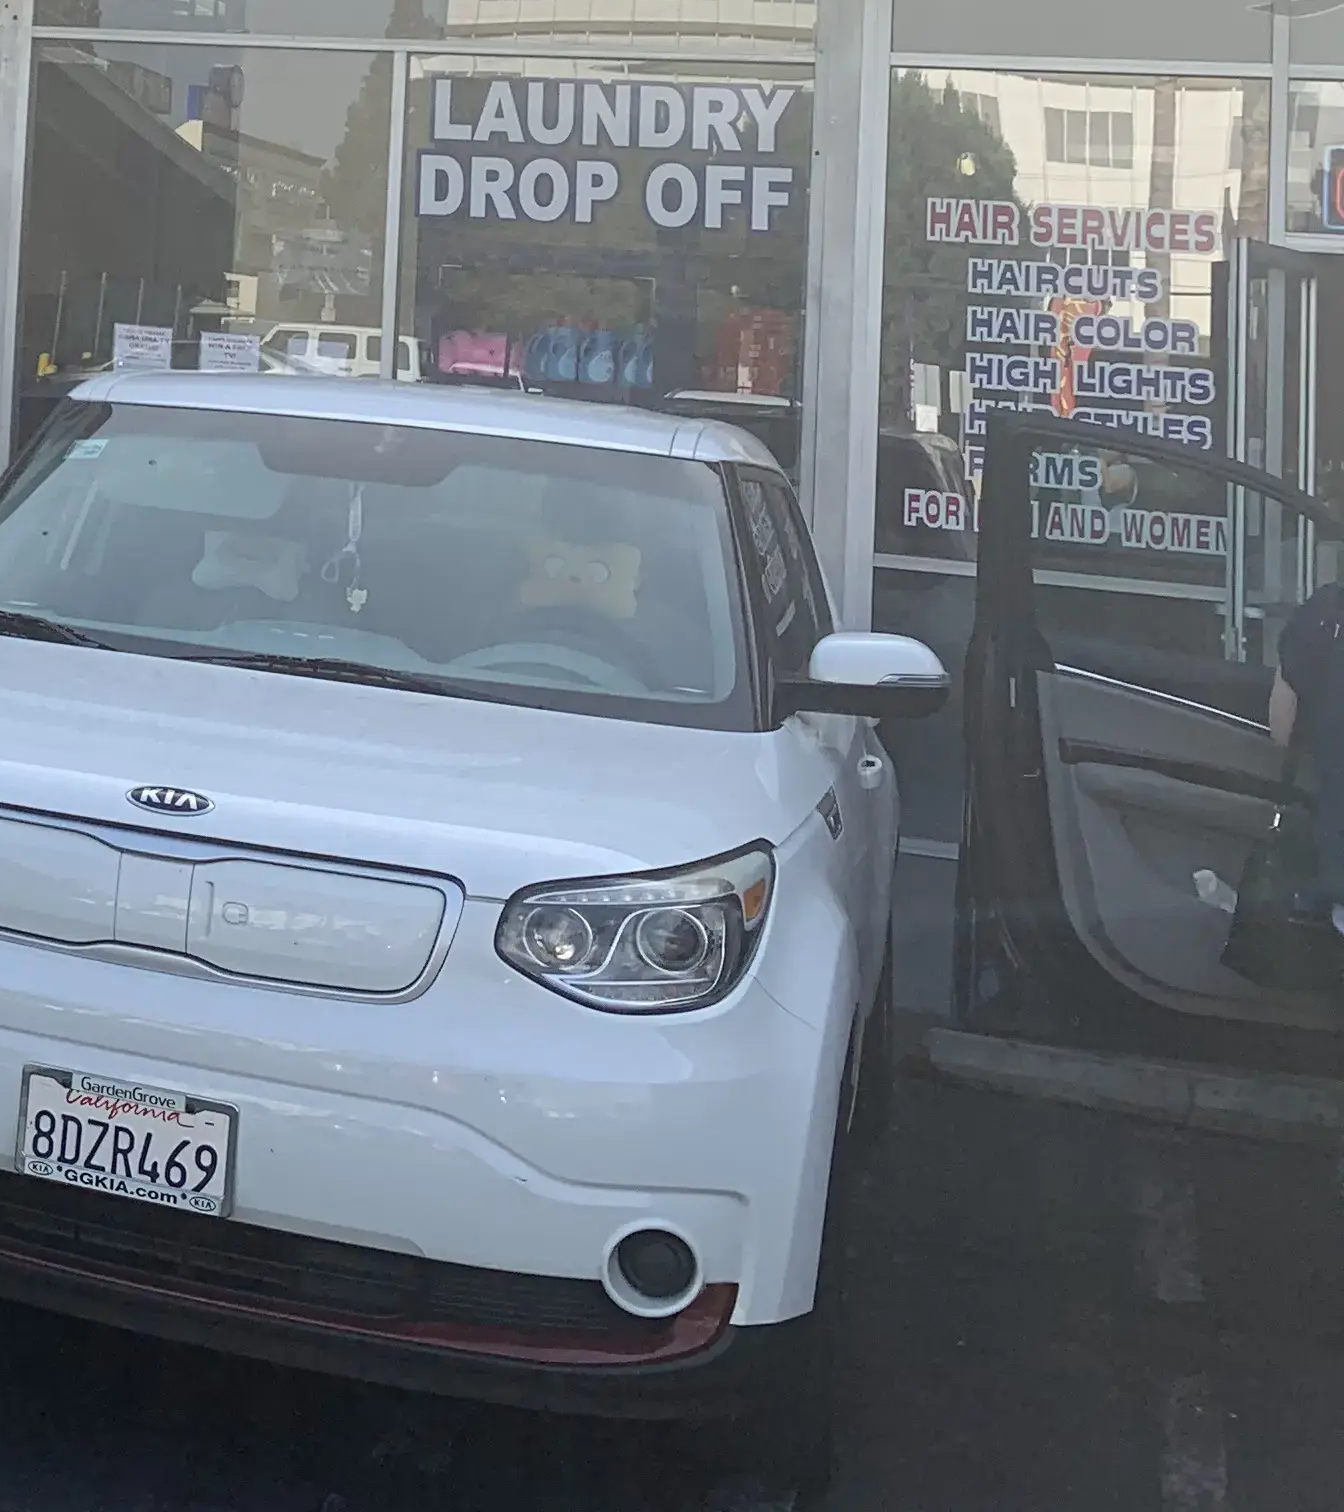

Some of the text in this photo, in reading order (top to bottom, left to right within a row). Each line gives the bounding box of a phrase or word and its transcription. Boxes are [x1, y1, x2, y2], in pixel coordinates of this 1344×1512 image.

[432, 80, 795, 154] LAUNDRY
[420, 157, 793, 231] DROP OFF
[927, 197, 1217, 253] HAIR SERVICES
[968, 258, 1162, 301] HAIRCUTS
[967, 306, 1200, 355] HAIR COLOR
[966, 353, 1215, 404] HIGH LIGHTS
[904, 489, 964, 531] FOR
[1046, 504, 1108, 544] AND
[139, 786, 199, 812] KIA
[66, 1088, 195, 1128] California
[32, 1110, 218, 1193] 8DZR469
[31, 1161, 213, 1210] KIA GGKIA.com KIA
